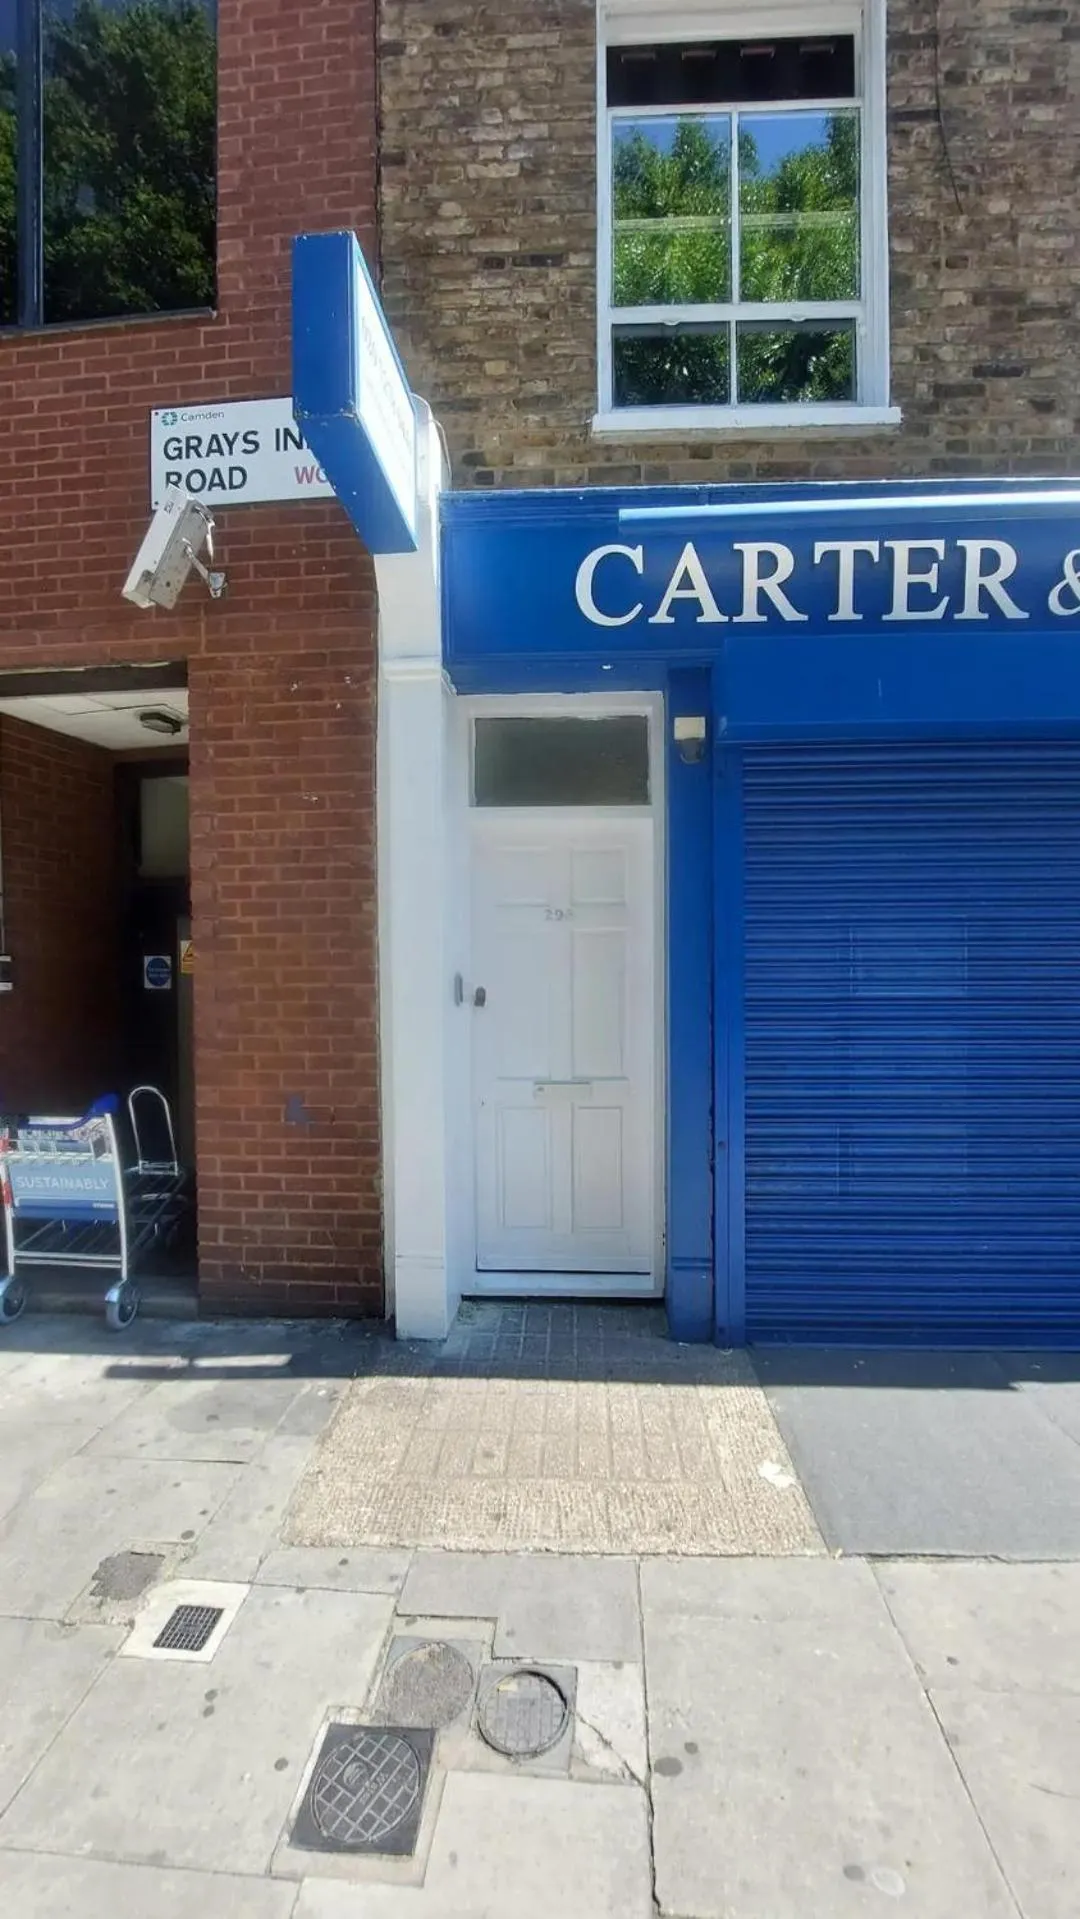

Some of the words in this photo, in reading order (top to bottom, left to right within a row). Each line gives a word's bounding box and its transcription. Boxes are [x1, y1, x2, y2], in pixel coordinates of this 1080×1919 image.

[180, 409, 225, 422] Camden
[163, 429, 260, 461] GRAYS
[275, 427, 310, 452] IN
[165, 465, 248, 494] ROAD
[575, 539, 1030, 627] CARTER
[16, 1176, 109, 1191] SUSTAINABLY
